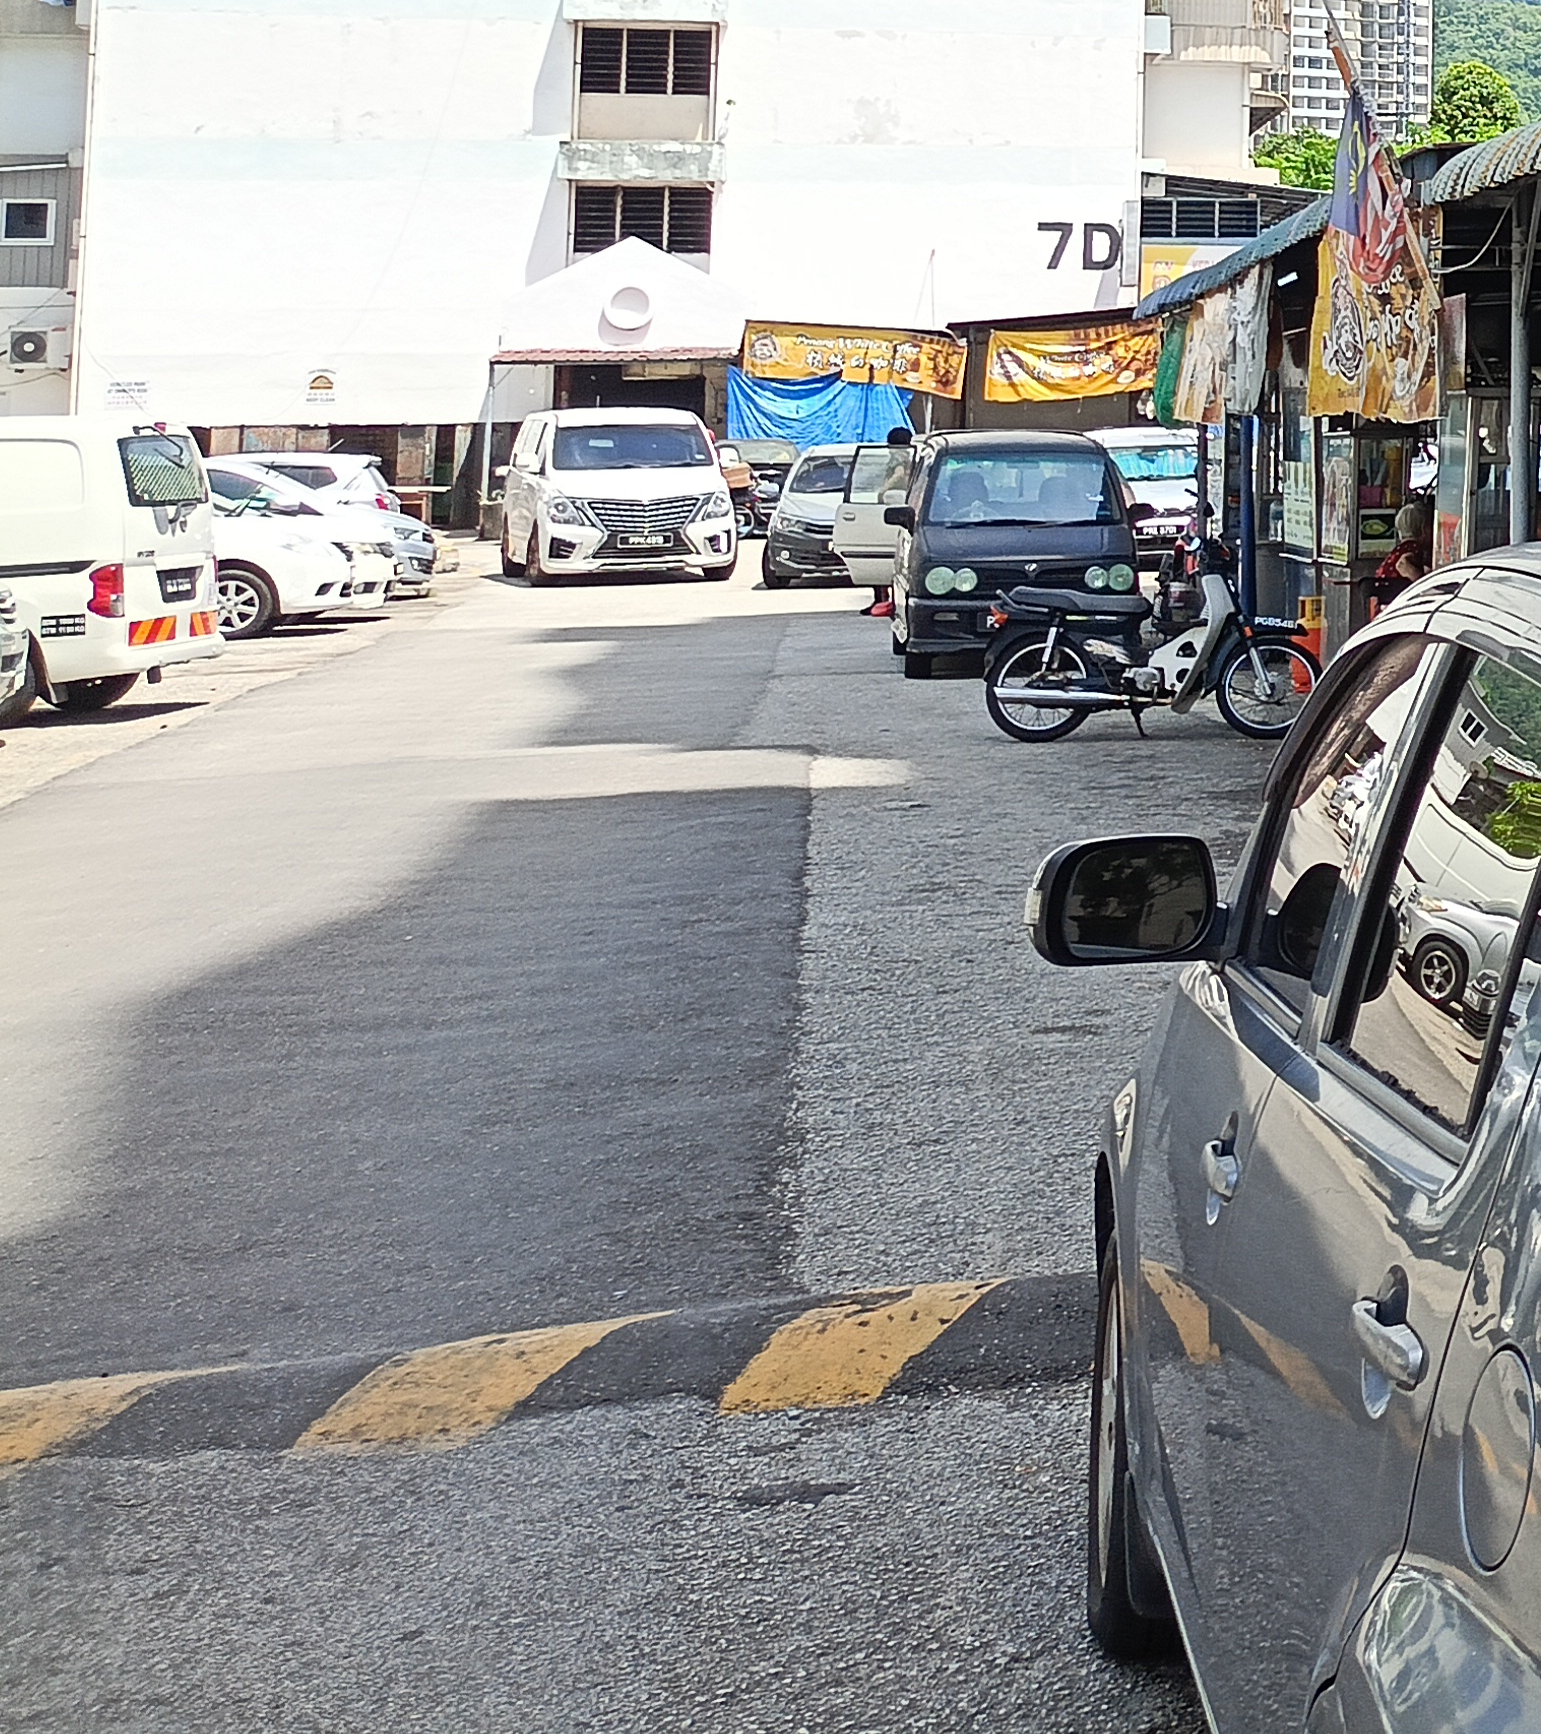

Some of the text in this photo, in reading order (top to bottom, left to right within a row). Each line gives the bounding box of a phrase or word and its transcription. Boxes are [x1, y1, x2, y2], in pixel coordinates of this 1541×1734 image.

[1037, 222, 1122, 270] 7D
[838, 336, 881, 350] White
[881, 341, 921, 356] Coffee
